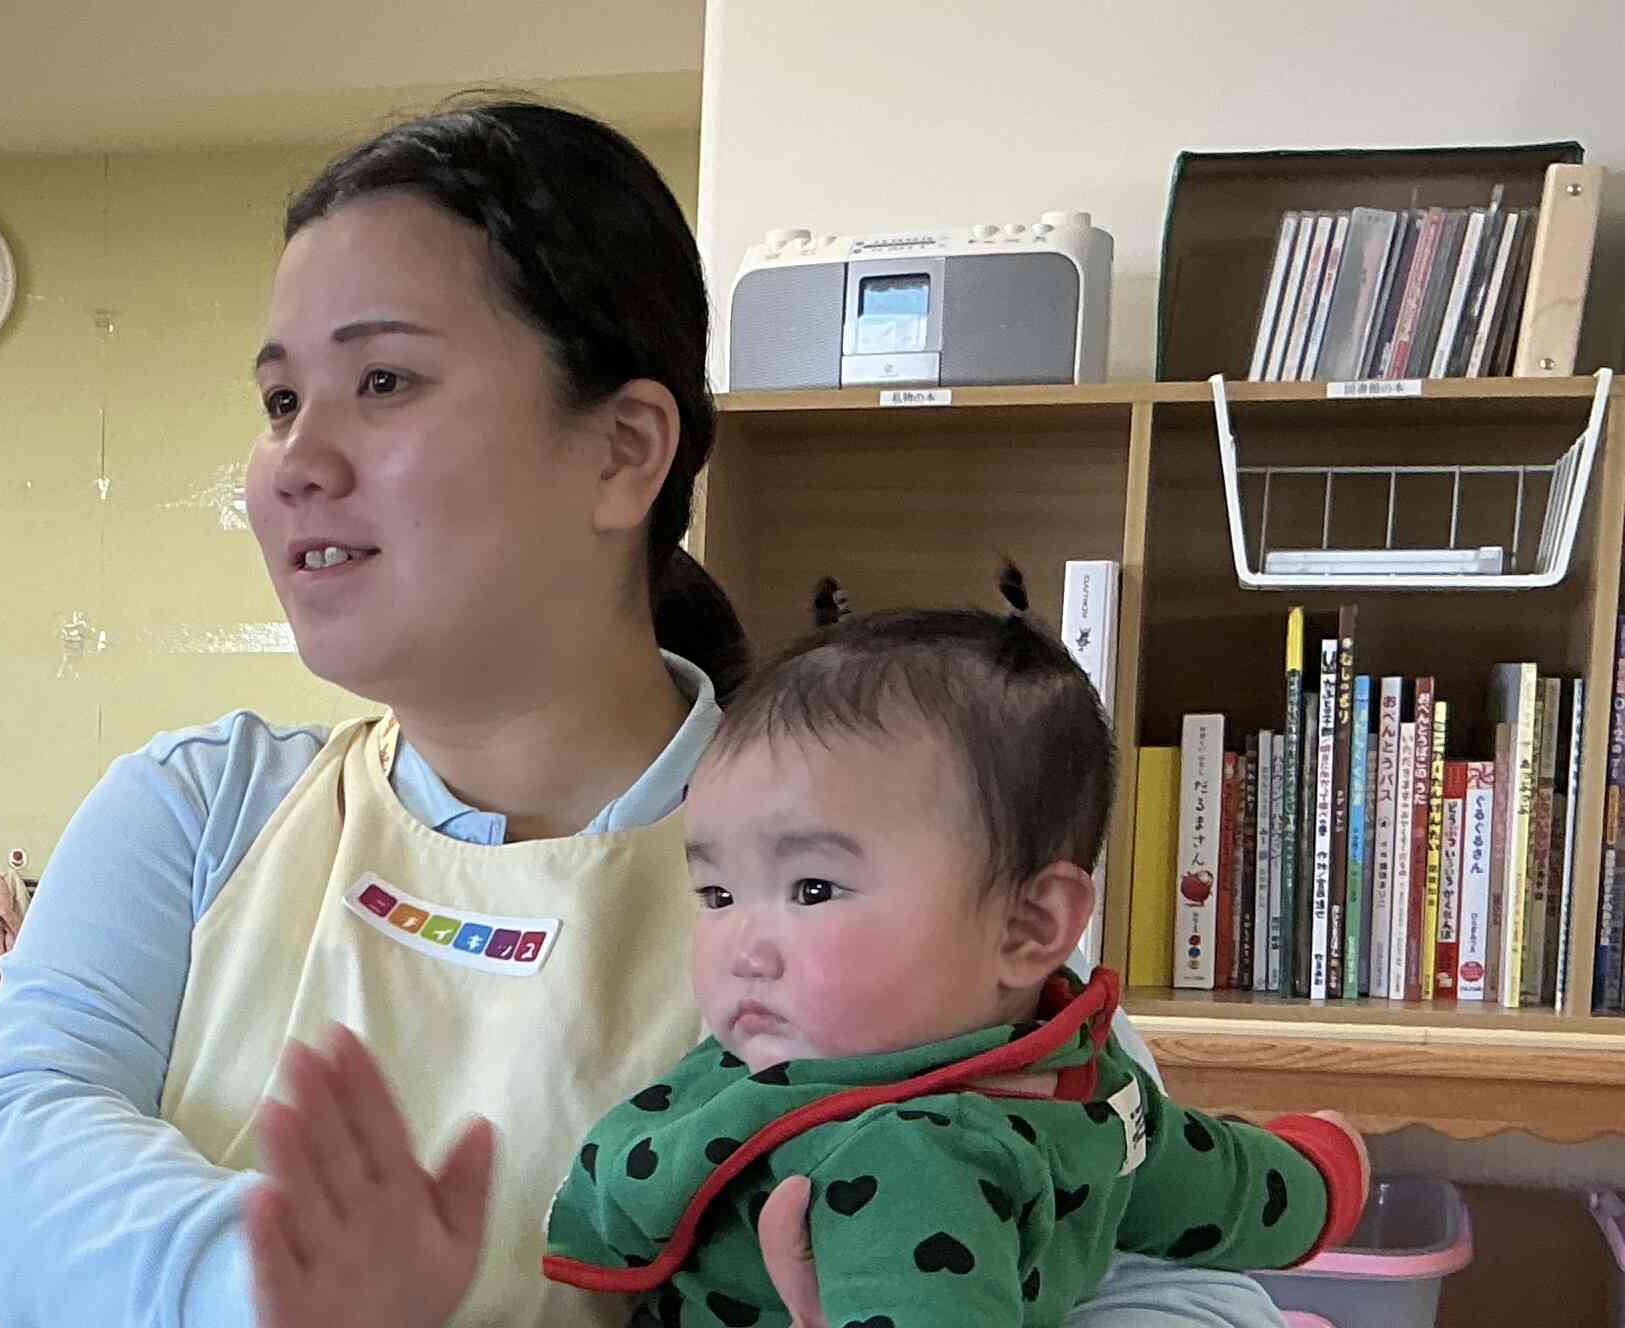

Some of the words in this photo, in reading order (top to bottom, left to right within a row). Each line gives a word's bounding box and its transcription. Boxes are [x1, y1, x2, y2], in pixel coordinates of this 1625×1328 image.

[1378, 695, 1398, 802] おべんとうバス
[1191, 780, 1210, 867] だるまさん
